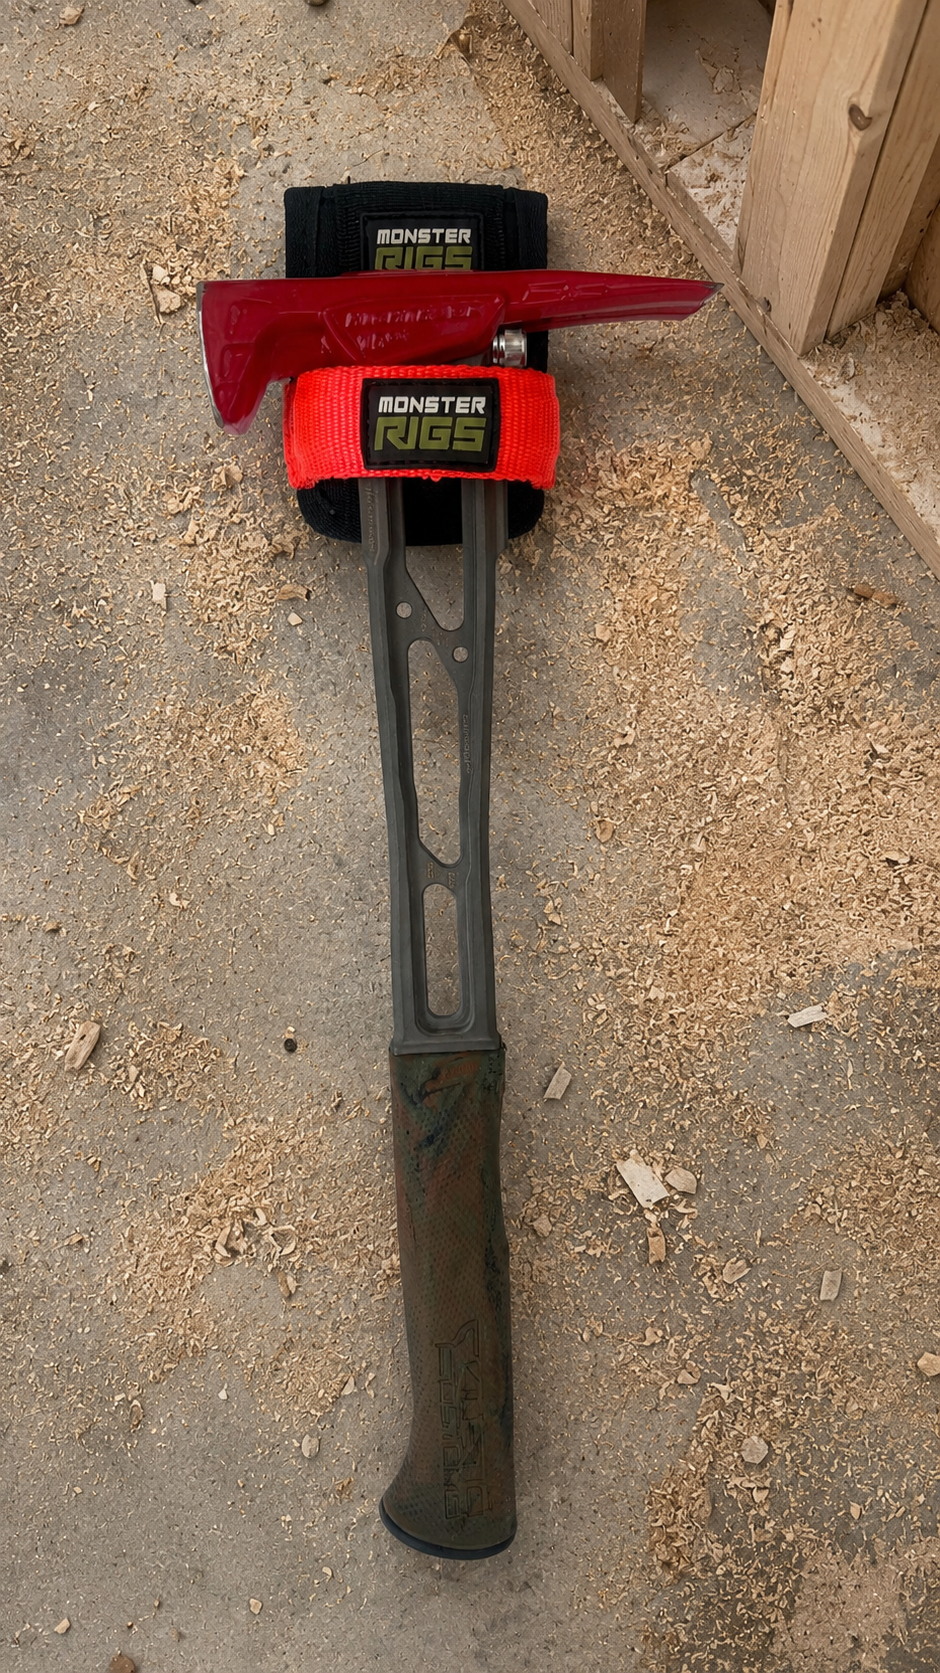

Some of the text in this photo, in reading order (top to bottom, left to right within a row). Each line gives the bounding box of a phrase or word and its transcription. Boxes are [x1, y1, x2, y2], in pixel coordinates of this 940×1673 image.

[376, 228, 472, 244] MONSTER
[375, 246, 473, 270] RIGS
[378, 396, 486, 414] MONSTER
[374, 416, 487, 452] RIGS
